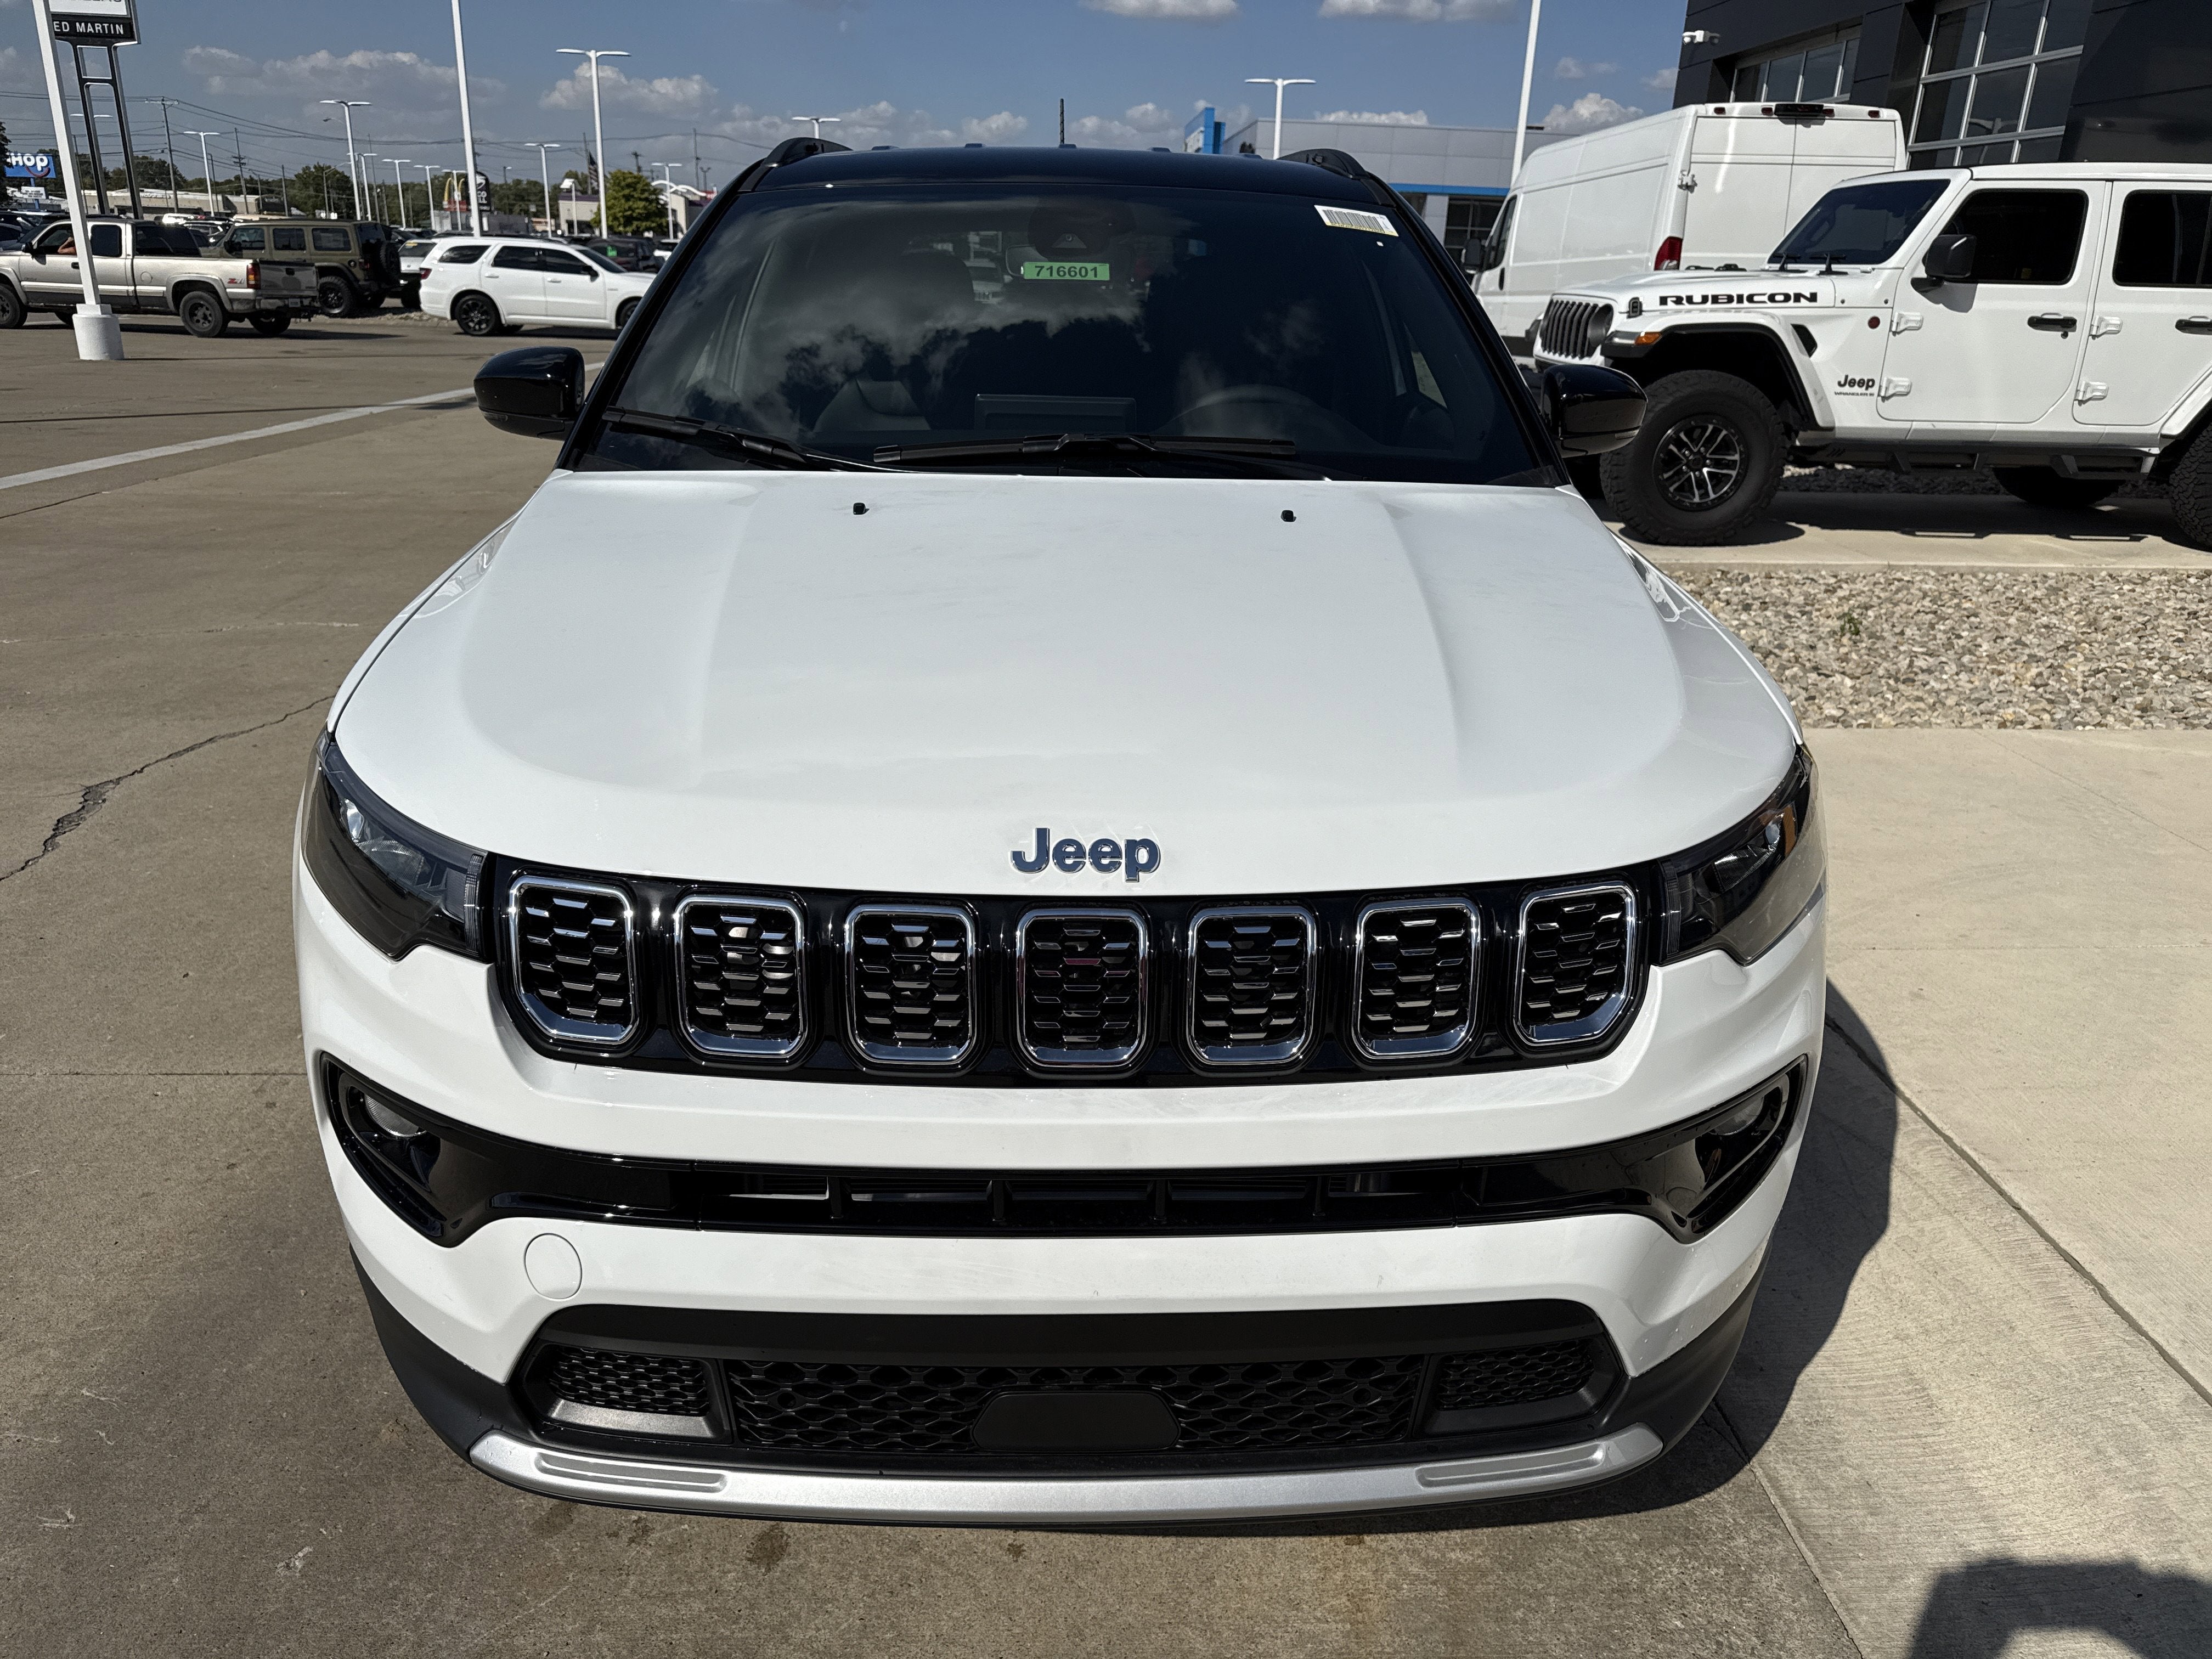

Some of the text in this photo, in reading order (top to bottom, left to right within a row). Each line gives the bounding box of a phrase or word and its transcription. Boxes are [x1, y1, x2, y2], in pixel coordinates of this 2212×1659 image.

[53, 21, 124, 35] ED MARTIN
[1035, 266, 1098, 278] 716601
[1659, 292, 1818, 306] RUBICON
[1837, 374, 1875, 391] Jeep
[1010, 827, 1161, 883] Jeep
